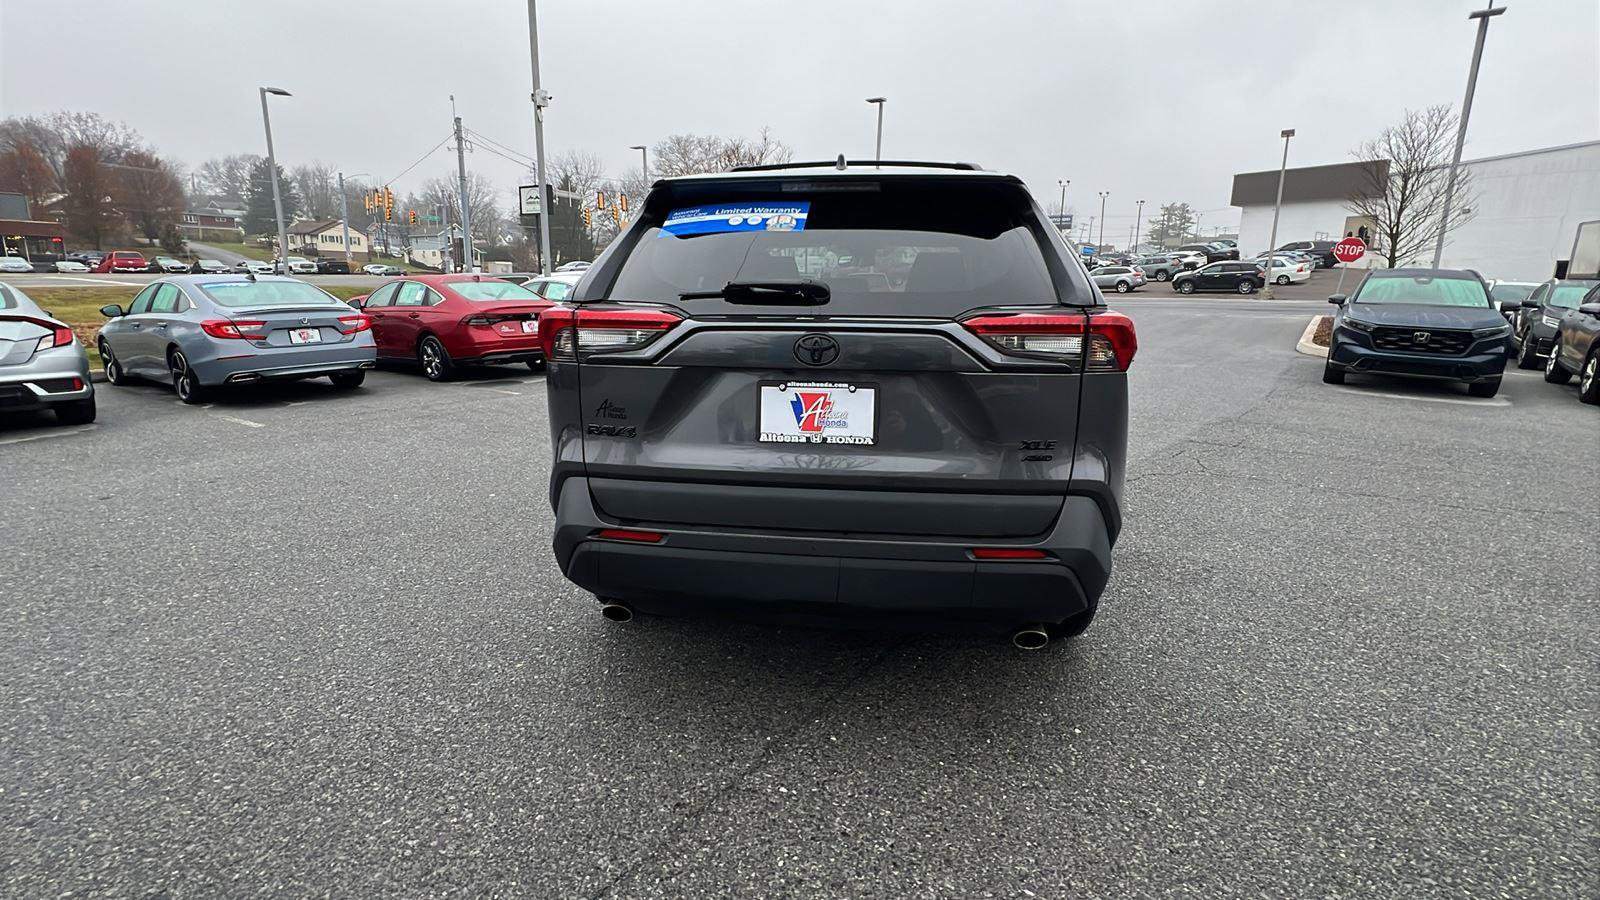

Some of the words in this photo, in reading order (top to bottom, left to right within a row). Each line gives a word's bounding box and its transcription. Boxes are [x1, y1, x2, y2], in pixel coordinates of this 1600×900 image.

[715, 207, 753, 215] Limited
[753, 206, 802, 215] Warranty
[1336, 244, 1364, 256] STOP
[786, 381, 849, 389] altoonahonda.com
[818, 418, 848, 428] Honda
[587, 423, 637, 438] RAV4
[759, 432, 806, 443] Altoona
[826, 435, 874, 445] HONDA
[1018, 440, 1058, 451] XLE
